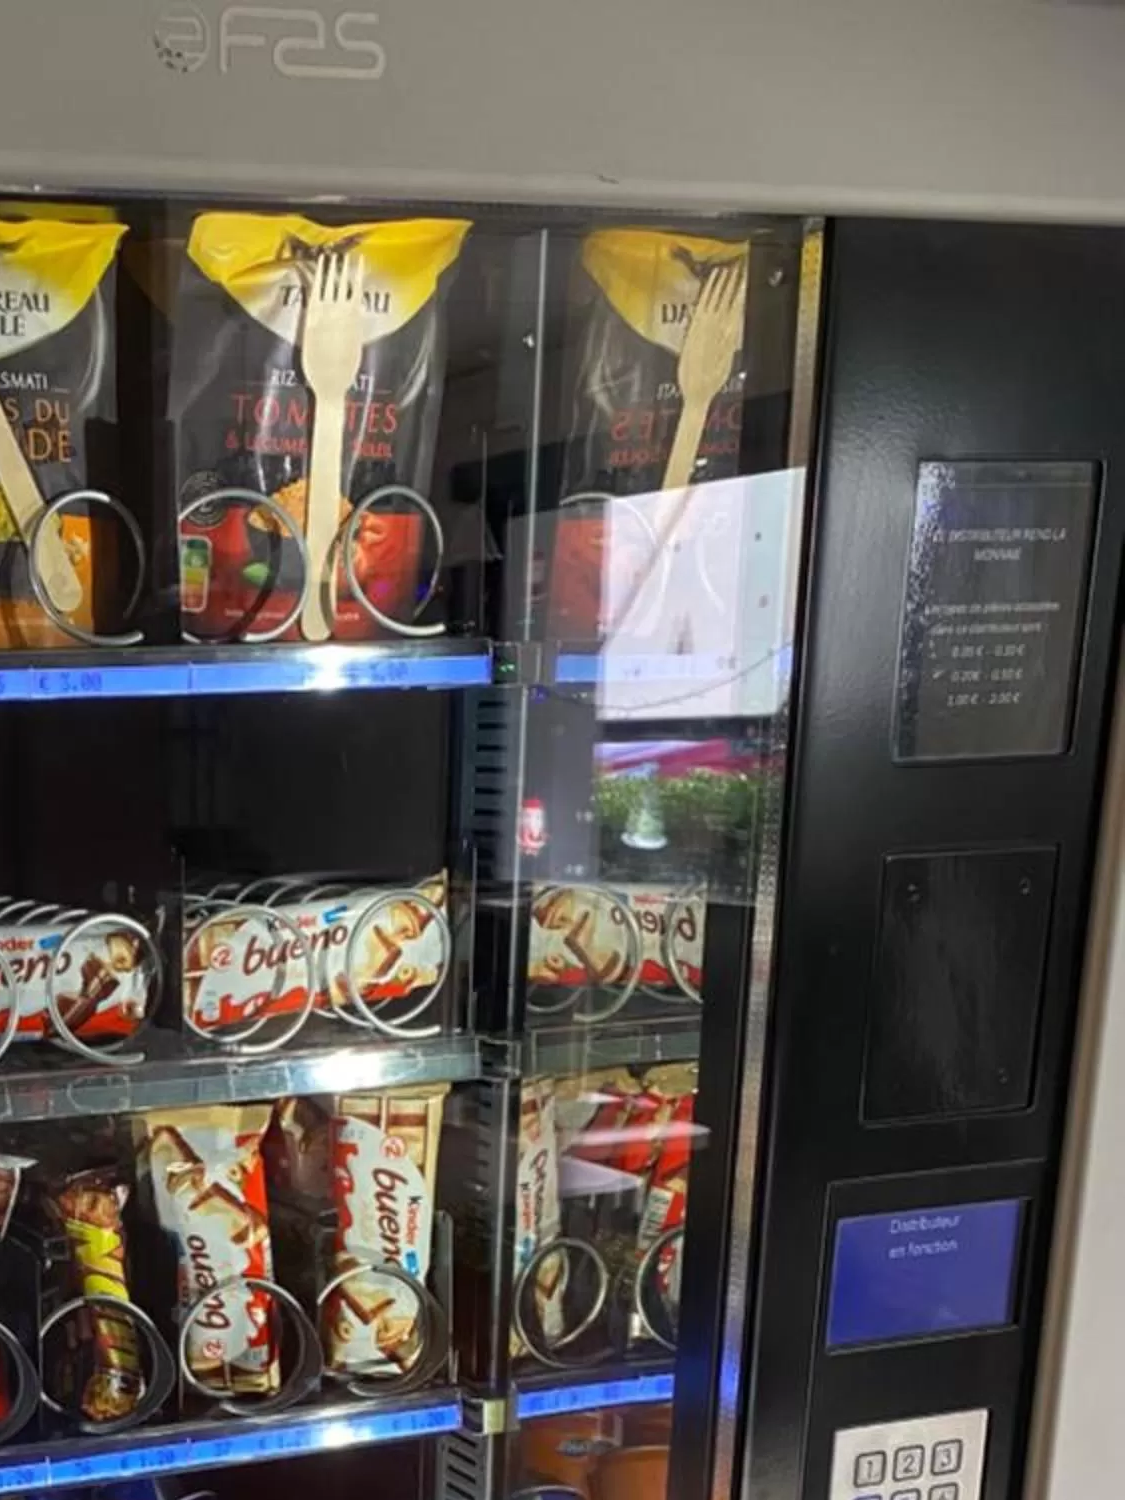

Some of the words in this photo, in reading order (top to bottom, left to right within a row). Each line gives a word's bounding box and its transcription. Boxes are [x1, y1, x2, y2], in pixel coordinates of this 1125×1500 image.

[35, 396, 70, 424] DU
[230, 392, 398, 434] TOMTES
[242, 924, 349, 977] bueno
[188, 1233, 233, 1331] bueno
[902, 1452, 915, 1475] 2
